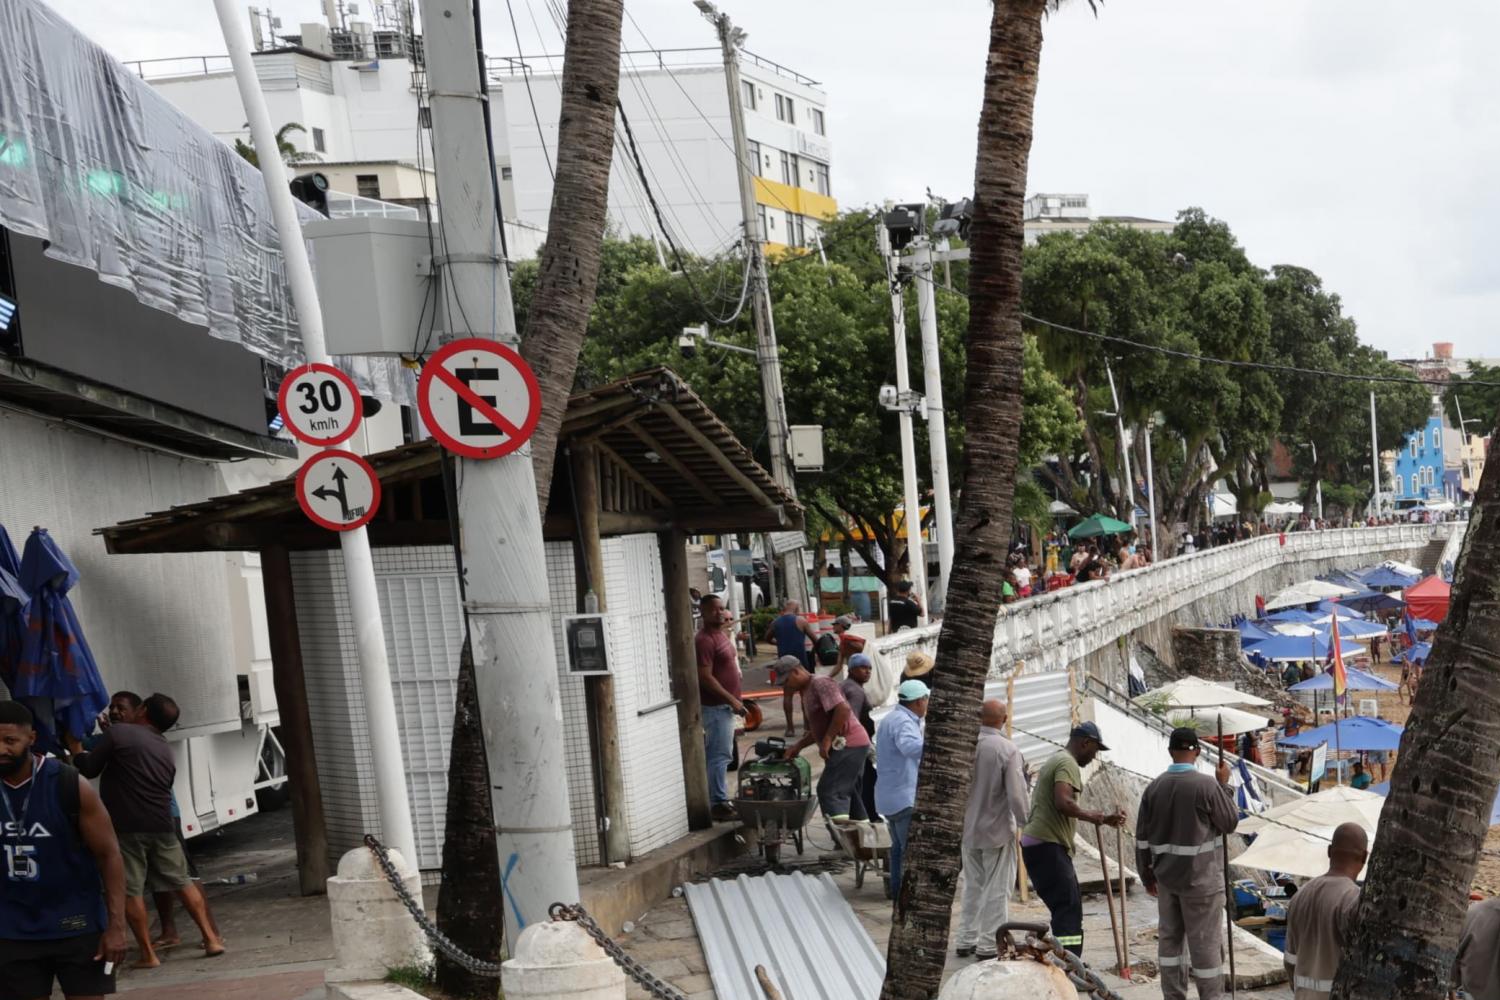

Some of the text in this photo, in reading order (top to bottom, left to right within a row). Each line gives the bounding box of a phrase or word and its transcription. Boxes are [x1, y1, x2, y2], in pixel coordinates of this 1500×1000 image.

[296, 379, 342, 414] 30
[455, 368, 504, 436] E
[309, 416, 339, 432] km/h
[0, 821, 53, 838] SA
[3, 844, 39, 880] 15
